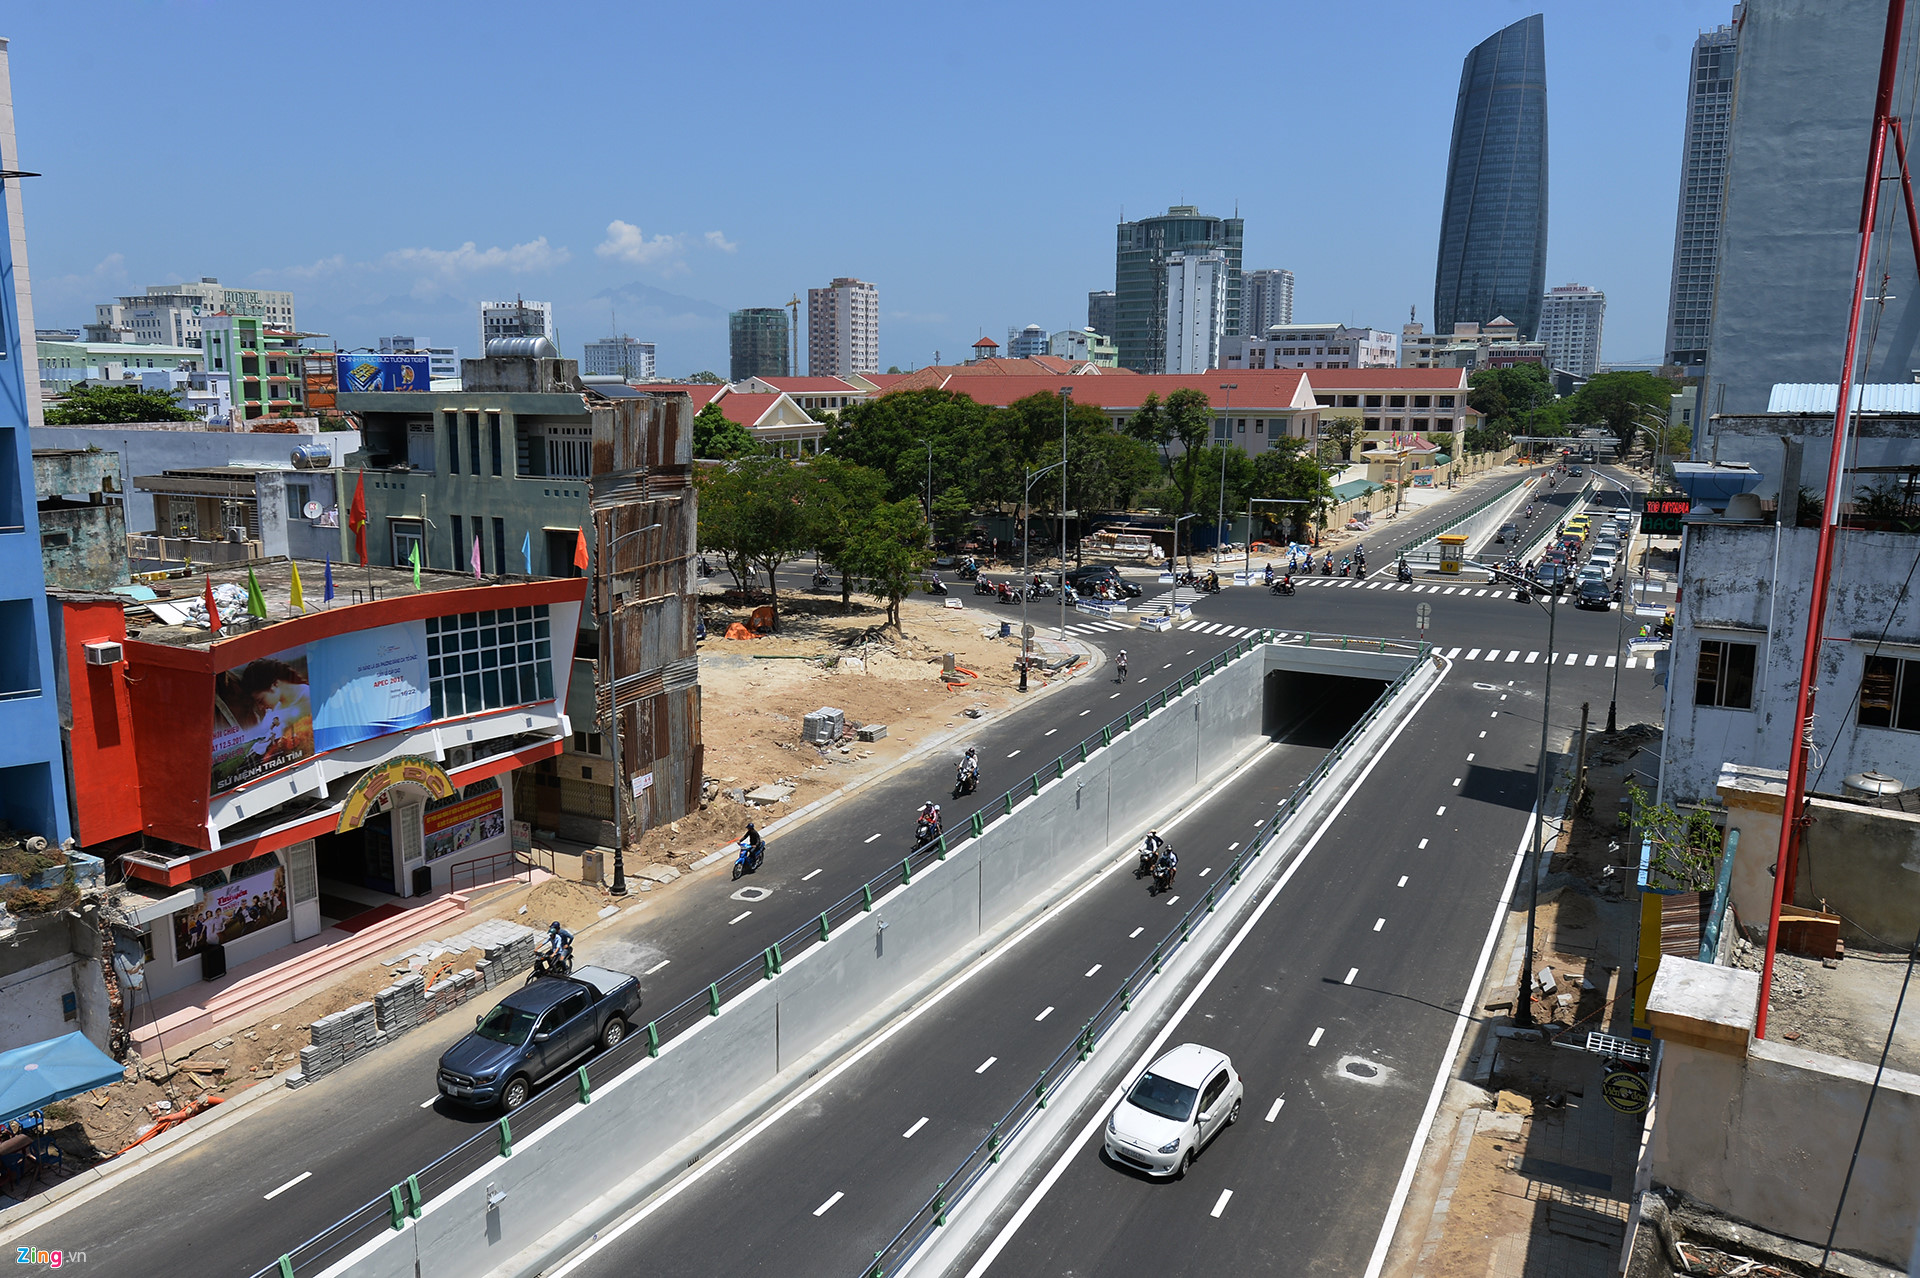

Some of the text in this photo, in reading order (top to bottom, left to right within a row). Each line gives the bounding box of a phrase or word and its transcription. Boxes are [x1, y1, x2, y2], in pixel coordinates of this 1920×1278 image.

[223, 291, 263, 304] HOTEL
[373, 679, 389, 688] APEC
[262, 755, 285, 770] TRÁI
